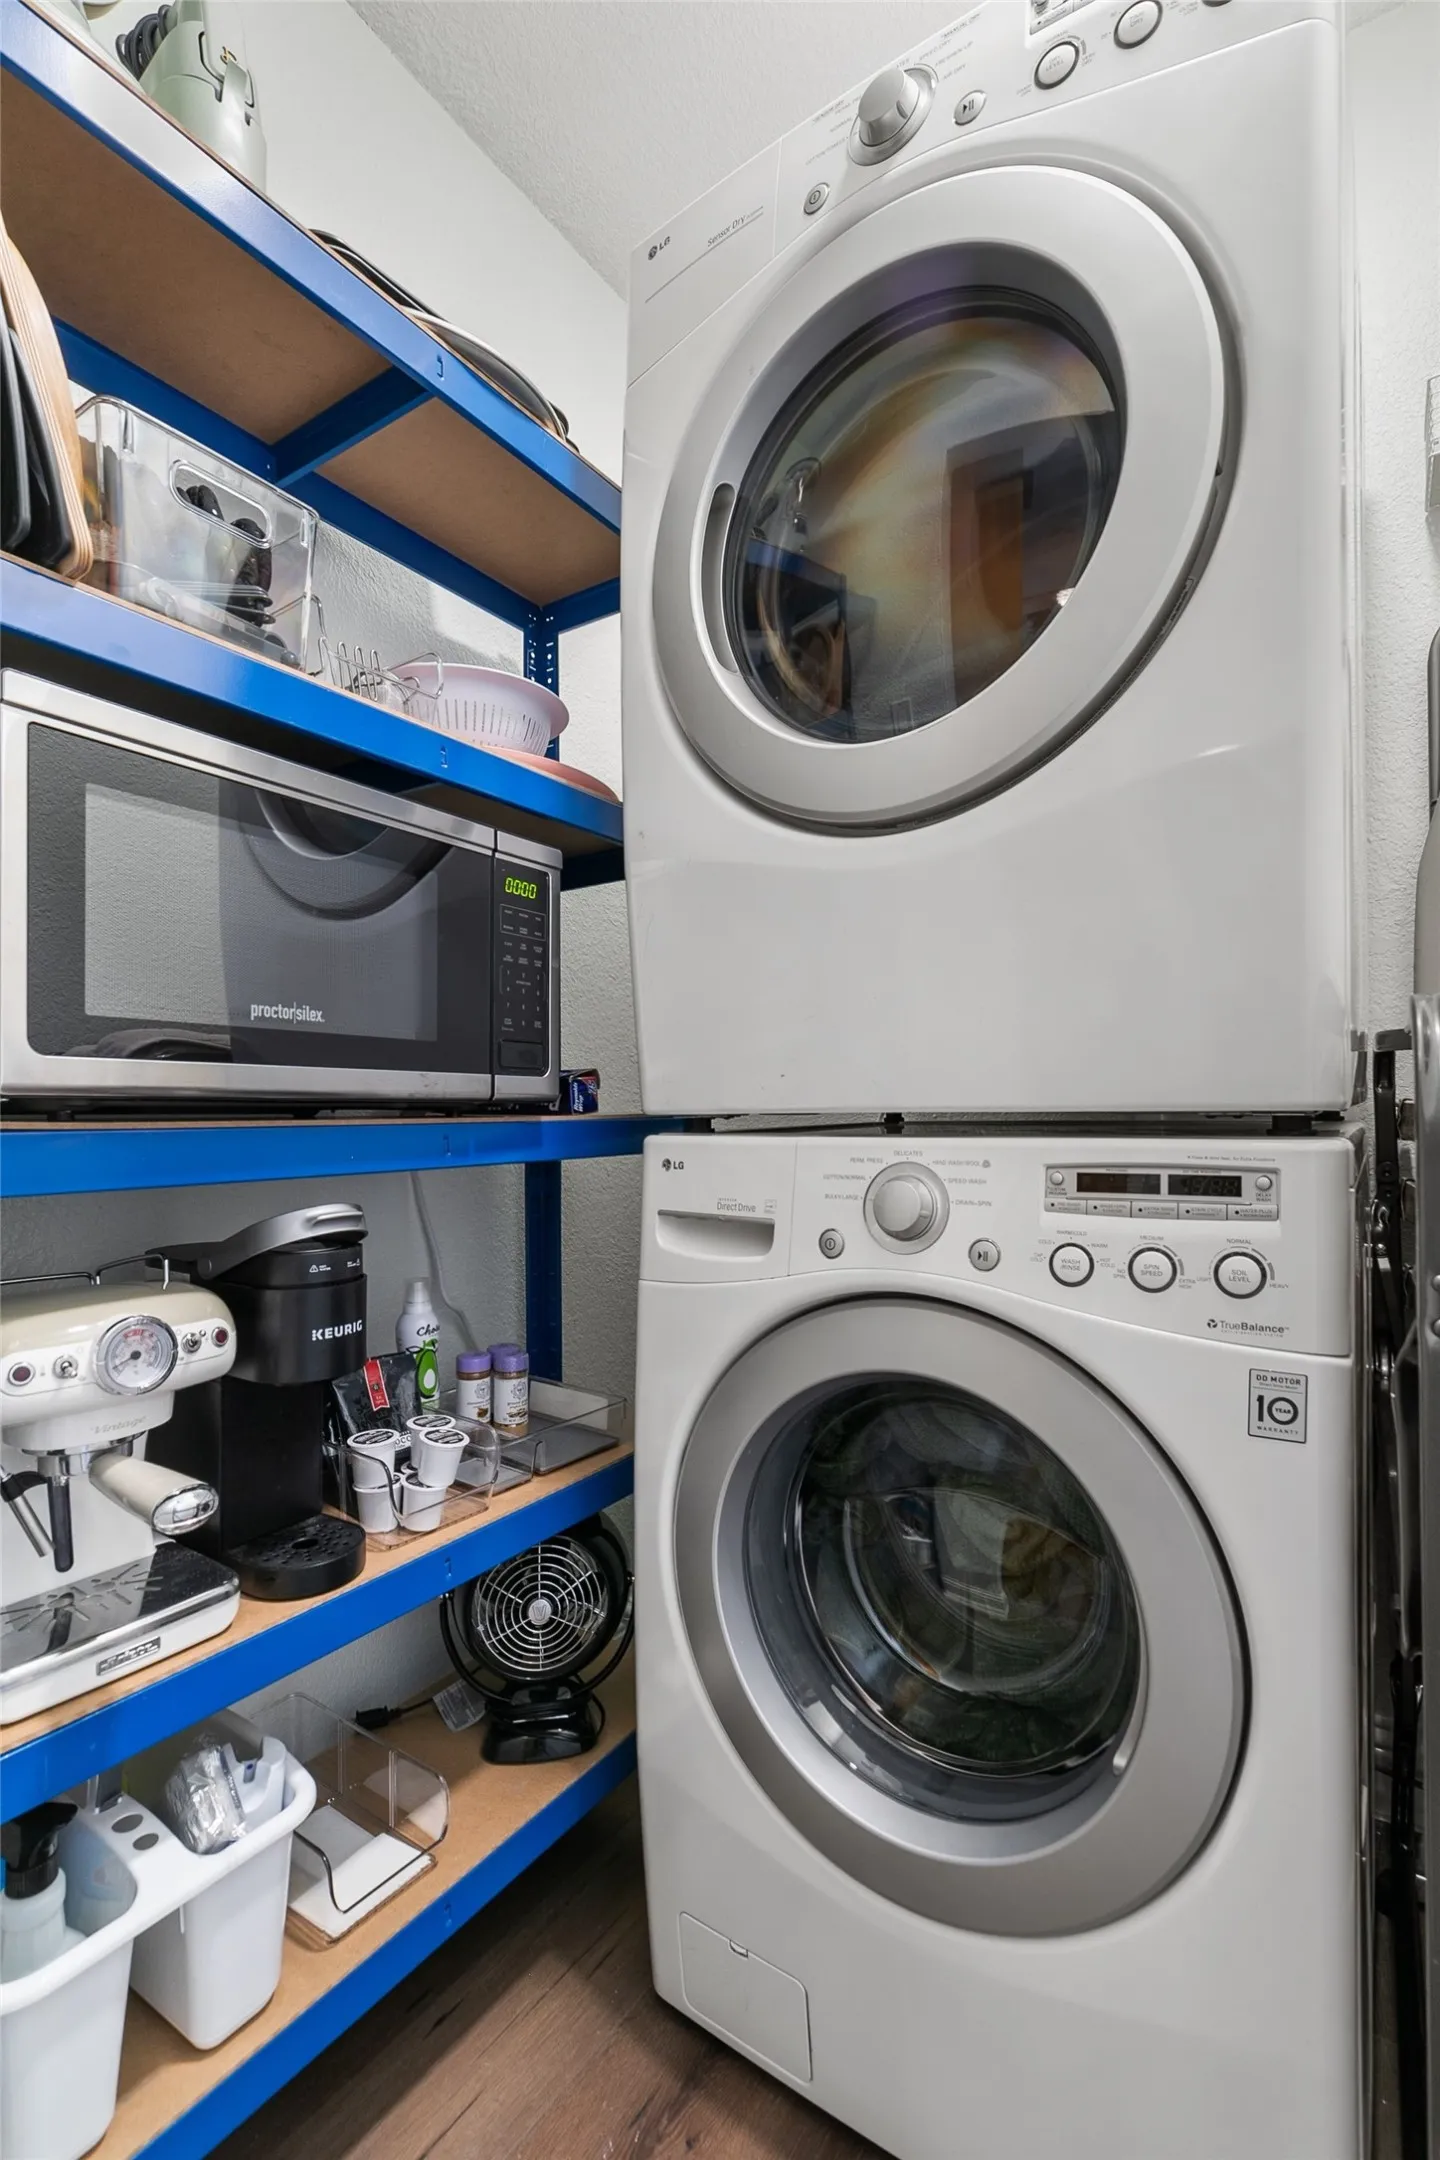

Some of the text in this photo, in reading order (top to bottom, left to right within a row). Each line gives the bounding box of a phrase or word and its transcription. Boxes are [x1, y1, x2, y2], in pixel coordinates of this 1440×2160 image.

[707, 215, 747, 247] Sensor Dry
[659, 236, 670, 251] LG
[893, 1150, 924, 1158] DELICATES
[673, 1160, 685, 1170] LG
[717, 1202, 738, 1212] Direct
[738, 1203, 757, 1213] Drive
[1140, 1269, 1164, 1277] SPEED
[1228, 1275, 1252, 1283] LEVEL
[311, 1319, 363, 1342] KEURIG
[1256, 1374, 1301, 1386] DD MOTOR
[1256, 1394, 1299, 1426] 10
[1256, 1425, 1299, 1435] WARRANTY
